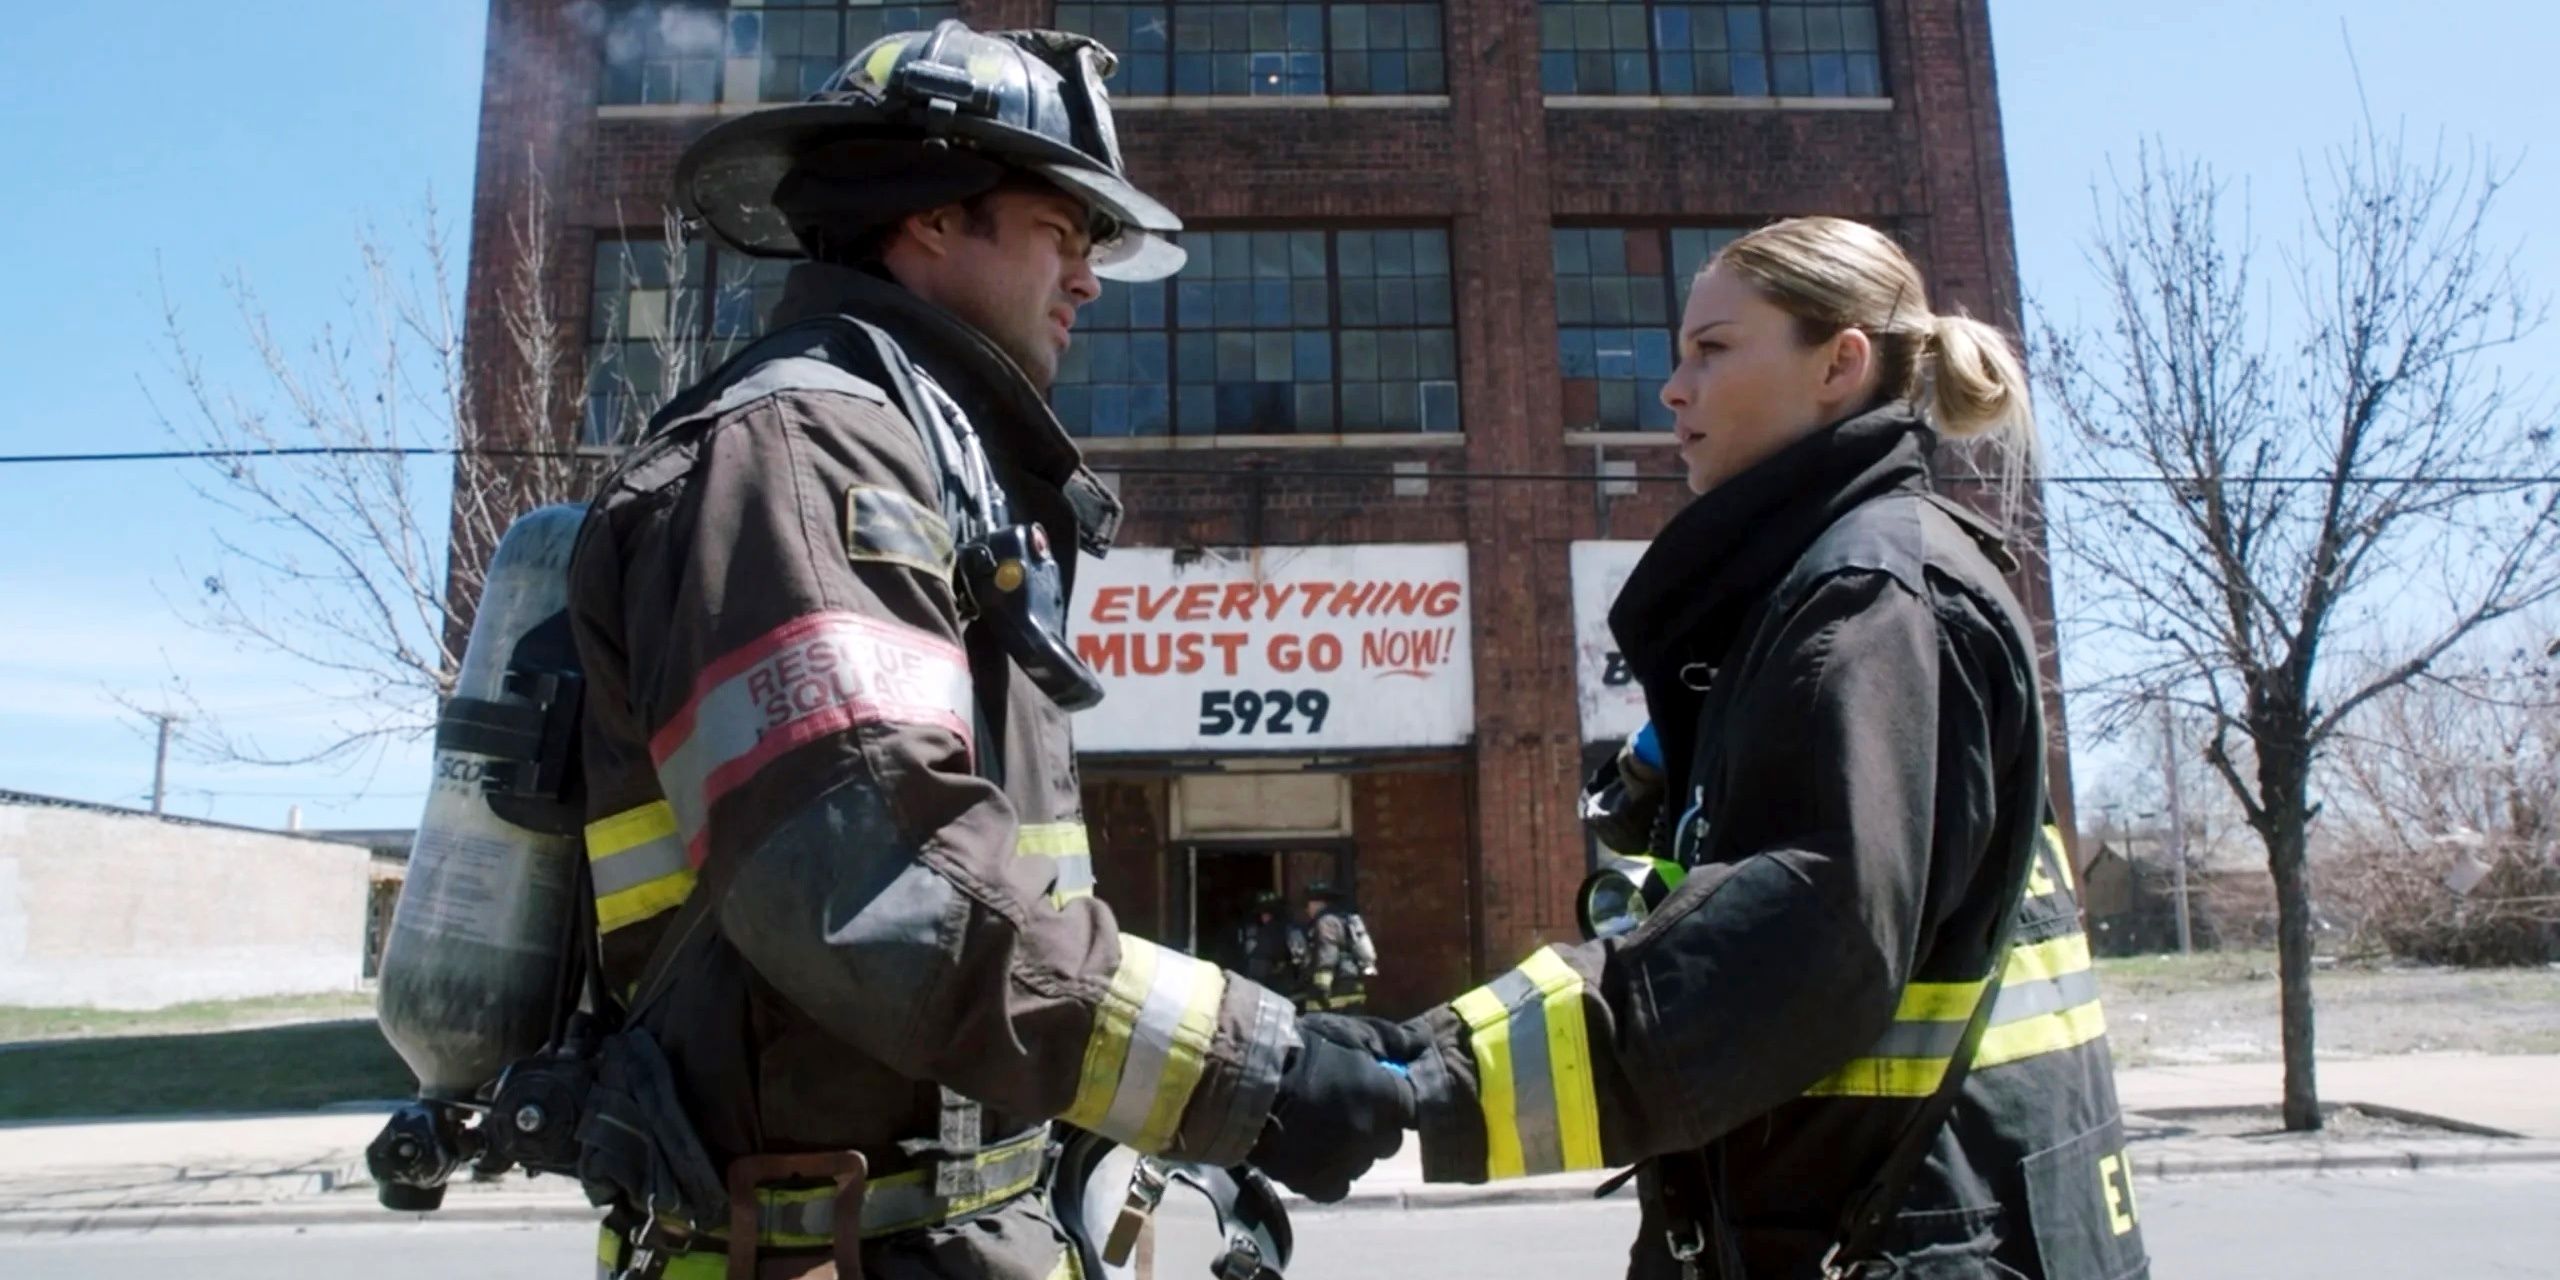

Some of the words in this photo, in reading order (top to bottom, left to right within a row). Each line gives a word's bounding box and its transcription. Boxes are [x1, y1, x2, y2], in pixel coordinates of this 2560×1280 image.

[1089, 581, 1461, 624] EVERYTHING
[1076, 632, 1249, 677] MUST
[1266, 632, 1343, 673] GO
[1361, 626, 1456, 670] NOW!
[1199, 689, 1331, 736] 5929
